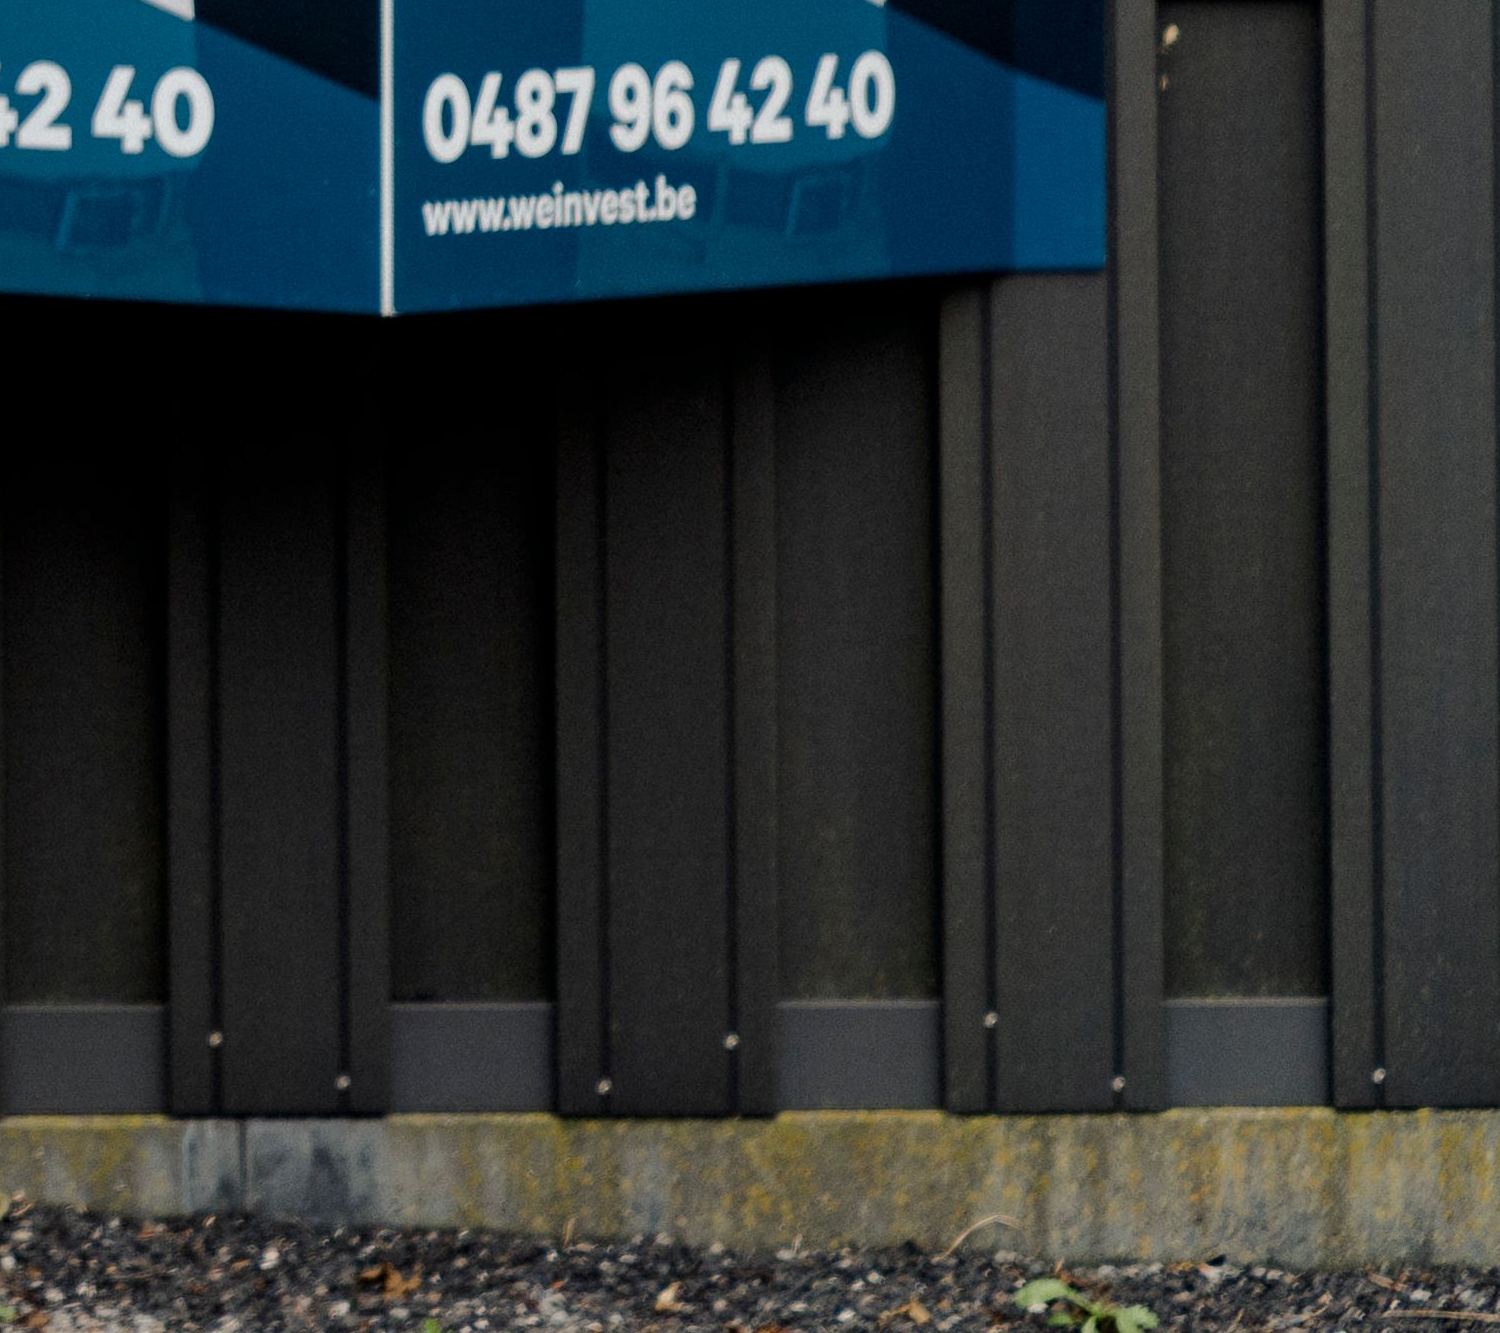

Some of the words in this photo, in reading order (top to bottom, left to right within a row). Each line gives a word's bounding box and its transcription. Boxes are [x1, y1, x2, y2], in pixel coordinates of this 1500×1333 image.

[92, 66, 215, 158] 40
[422, 66, 596, 164] 0487
[609, 60, 695, 153] 96
[708, 55, 793, 146] 42
[804, 50, 896, 139] 40
[422, 174, 698, 237] www.weinvest.be
